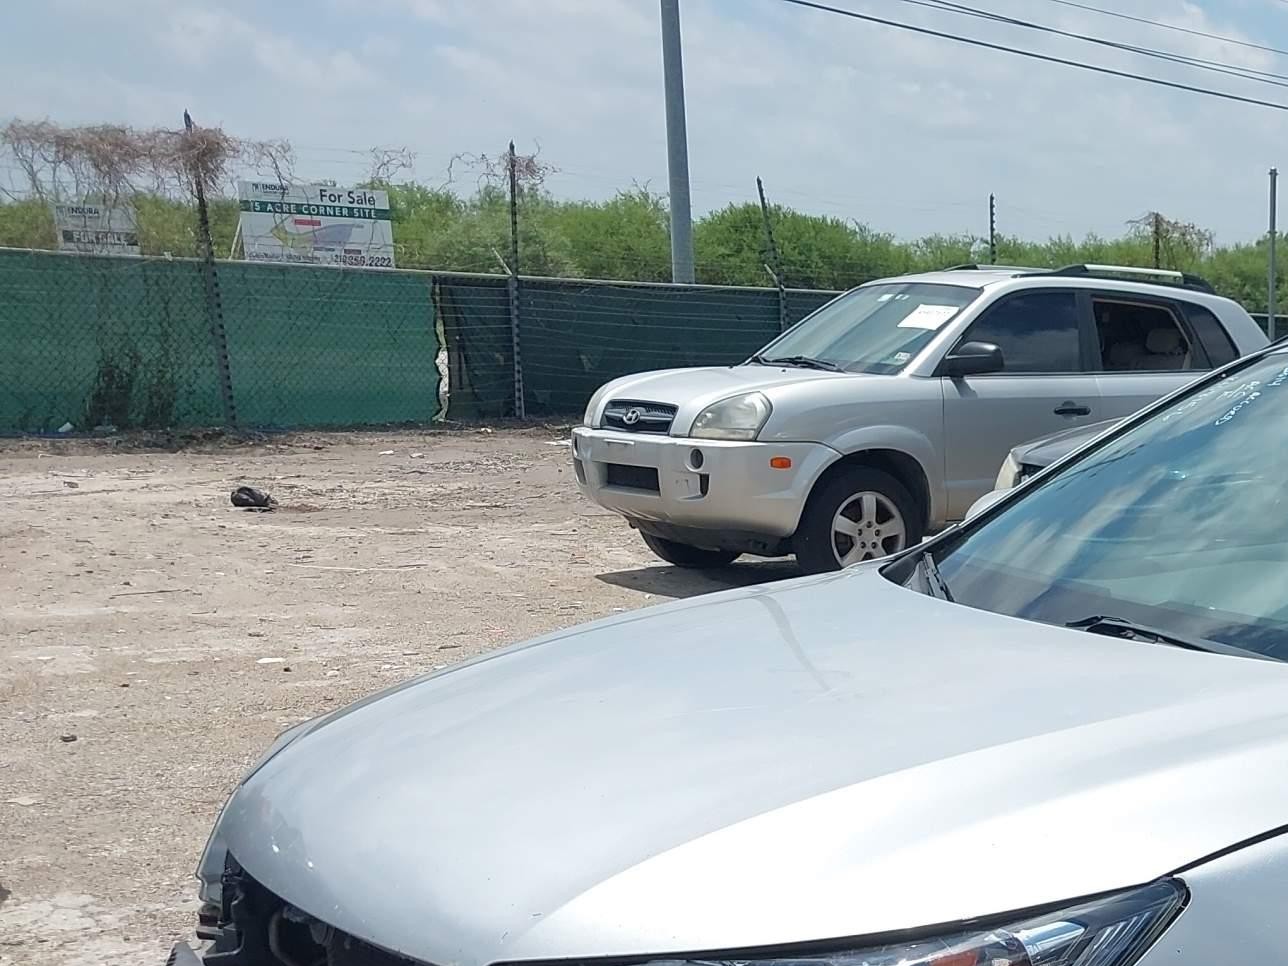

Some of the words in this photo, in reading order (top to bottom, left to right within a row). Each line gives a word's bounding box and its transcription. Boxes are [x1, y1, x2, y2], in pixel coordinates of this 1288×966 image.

[319, 189, 343, 204] For
[348, 191, 376, 206] Sale
[266, 203, 297, 213] ACRE
[302, 205, 349, 217] CORNER
[353, 207, 377, 218] SITE
